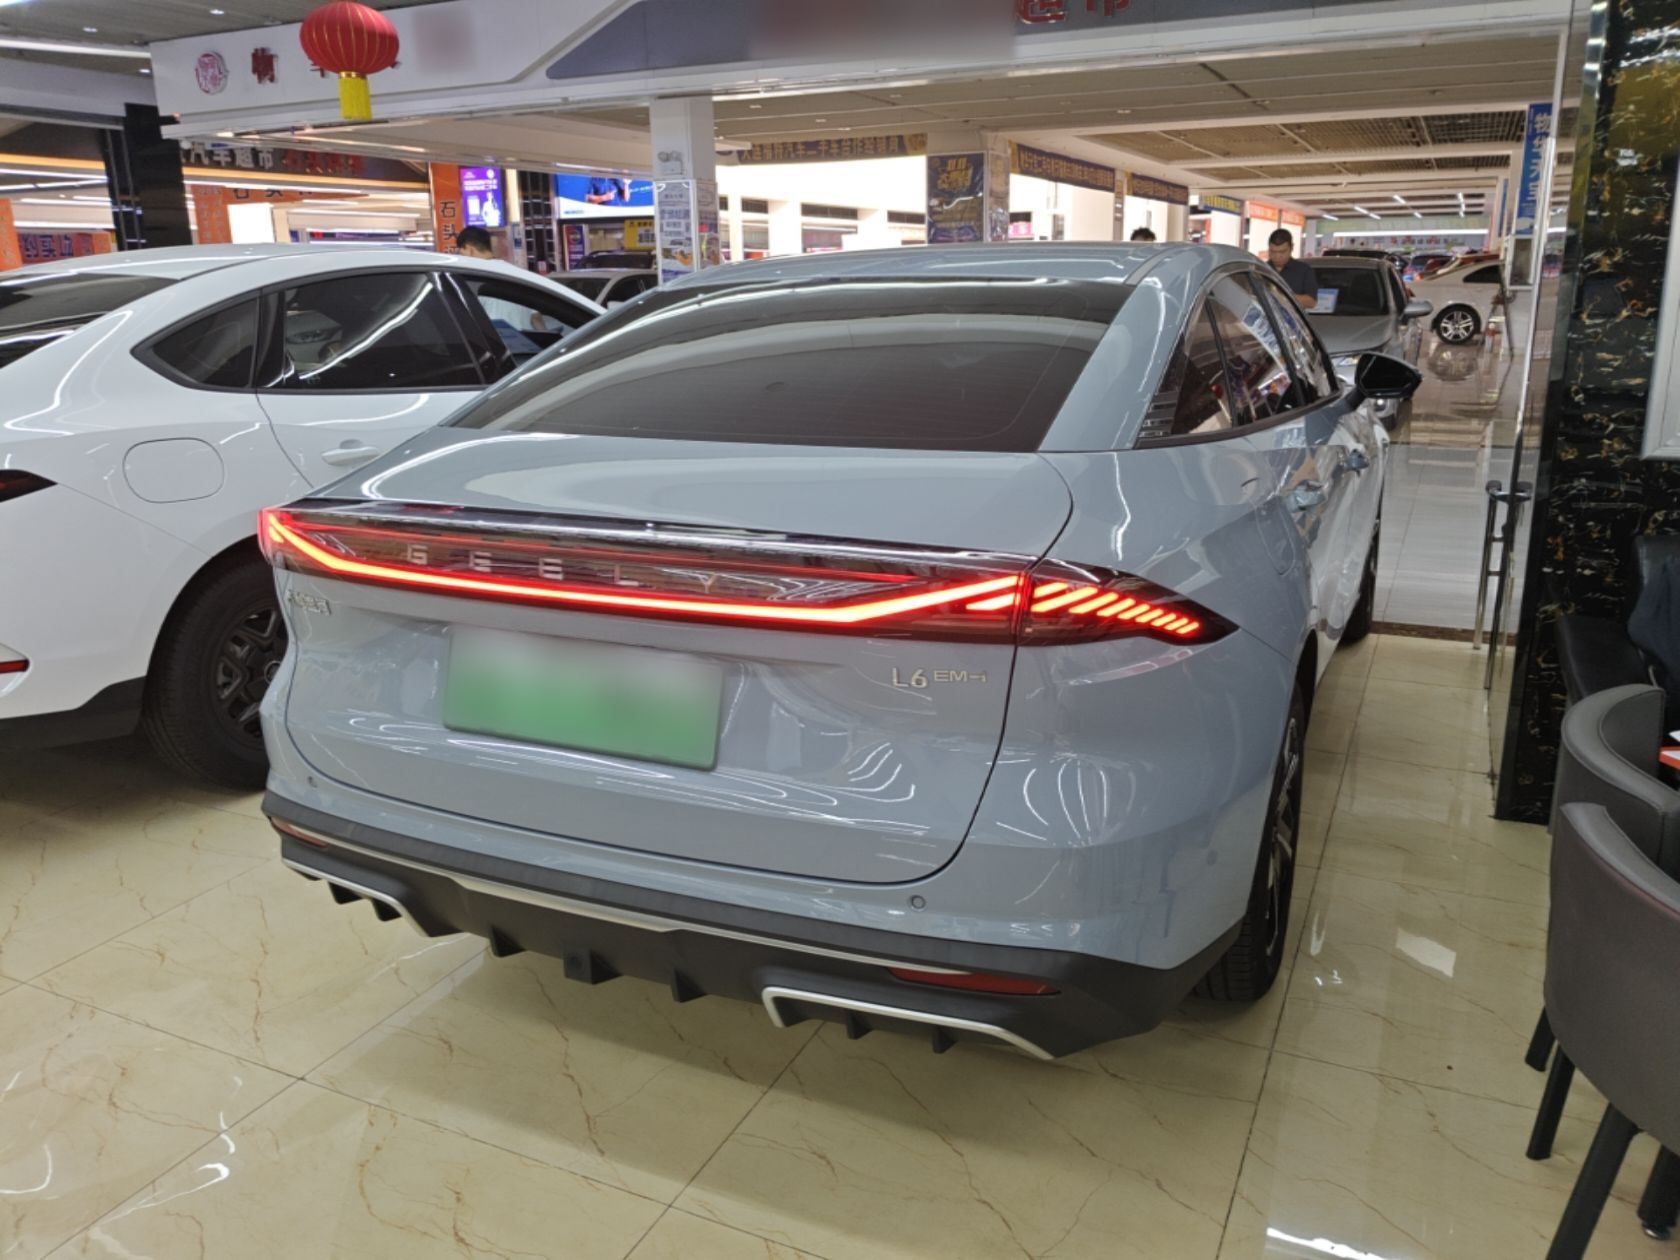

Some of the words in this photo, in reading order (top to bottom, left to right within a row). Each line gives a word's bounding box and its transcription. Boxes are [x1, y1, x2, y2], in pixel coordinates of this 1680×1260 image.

[181, 141, 274, 169] 汽车超市
[407, 544, 719, 594] GEELY
[891, 667, 928, 689] L6
